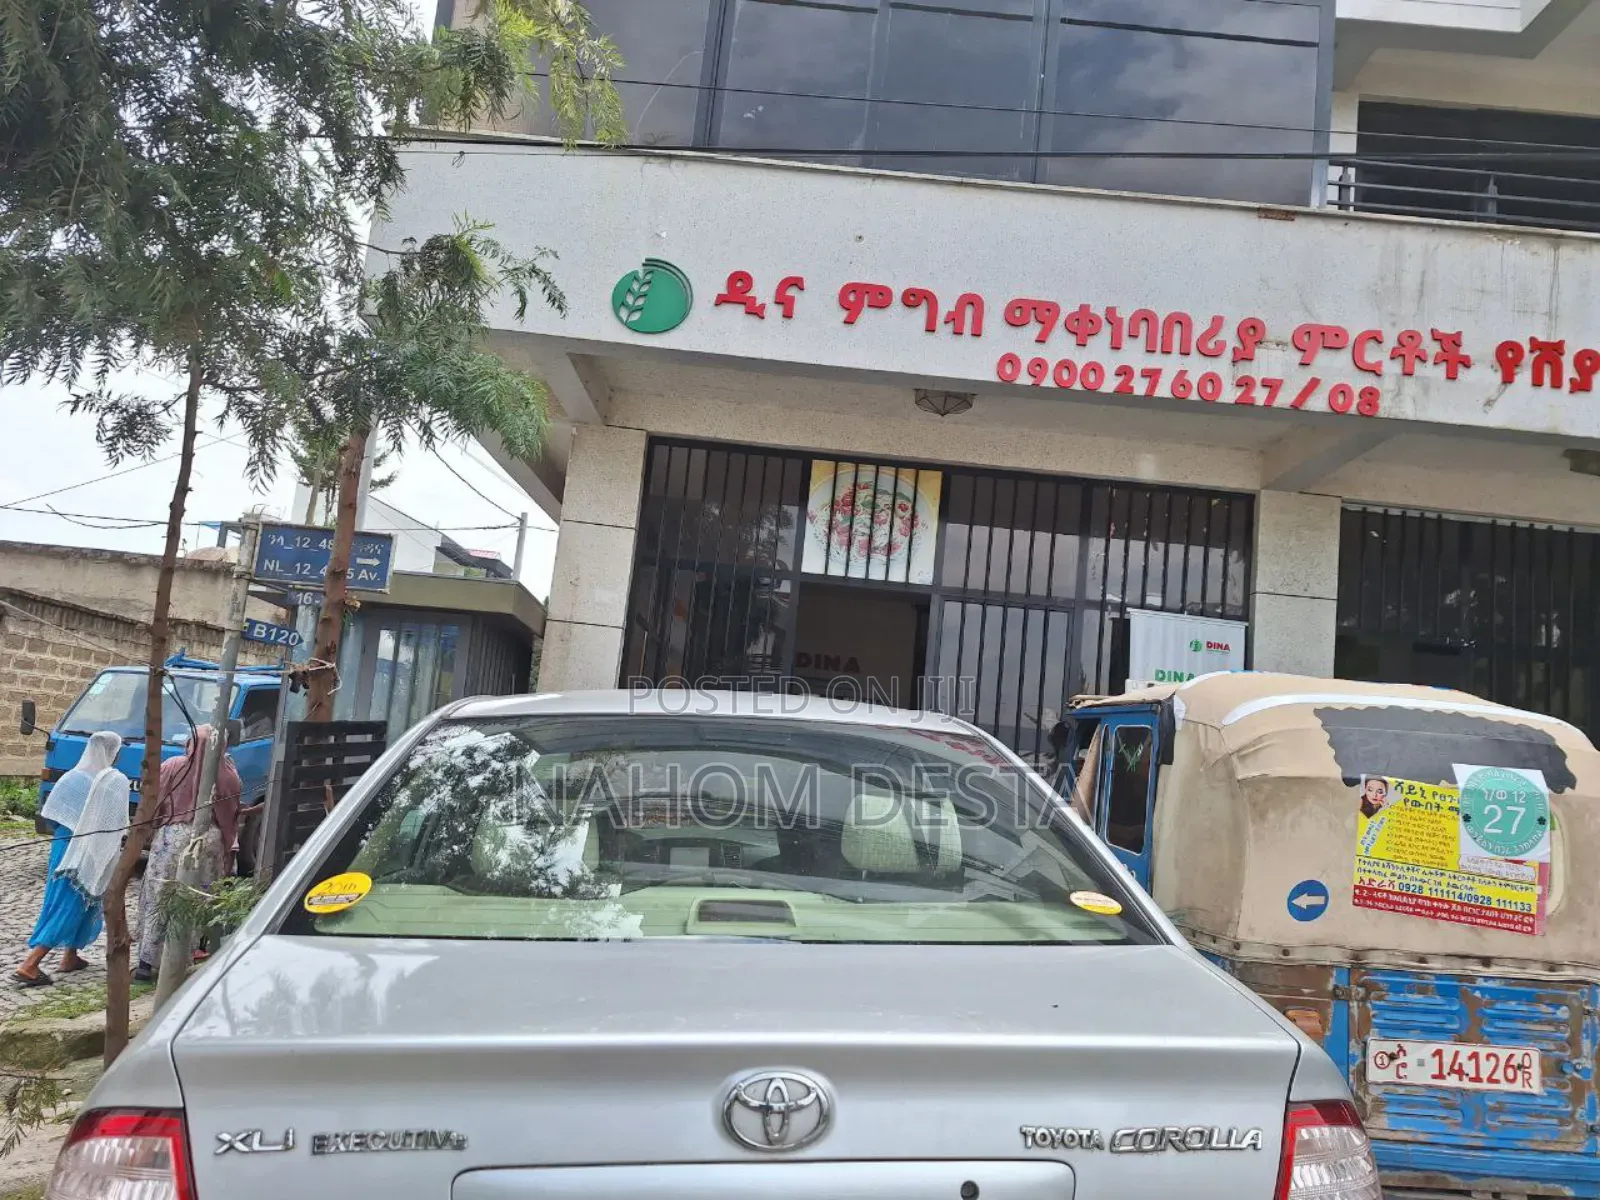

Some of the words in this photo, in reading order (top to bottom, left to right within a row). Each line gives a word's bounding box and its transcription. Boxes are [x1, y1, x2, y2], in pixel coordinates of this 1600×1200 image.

[714, 269, 805, 320] ዲና
[838, 281, 986, 337] ምግብ
[1004, 298, 1267, 363] ማቀነባበሪያ
[1293, 322, 1472, 380] ምርቶች
[253, 624, 300, 646] B120
[1206, 640, 1230, 652] DINA
[796, 652, 863, 673] DINA
[1155, 669, 1196, 682] DINA
[1512, 790, 1526, 804] 12
[1483, 804, 1527, 835] 27
[1398, 882, 1424, 894] 0928
[1428, 887, 1492, 906] 111114/0928
[1496, 899, 1532, 912] 111133
[1431, 1048, 1518, 1085] 14126
[1020, 1125, 1105, 1150] TOYOTA
[1110, 1127, 1263, 1152] COROLLA
